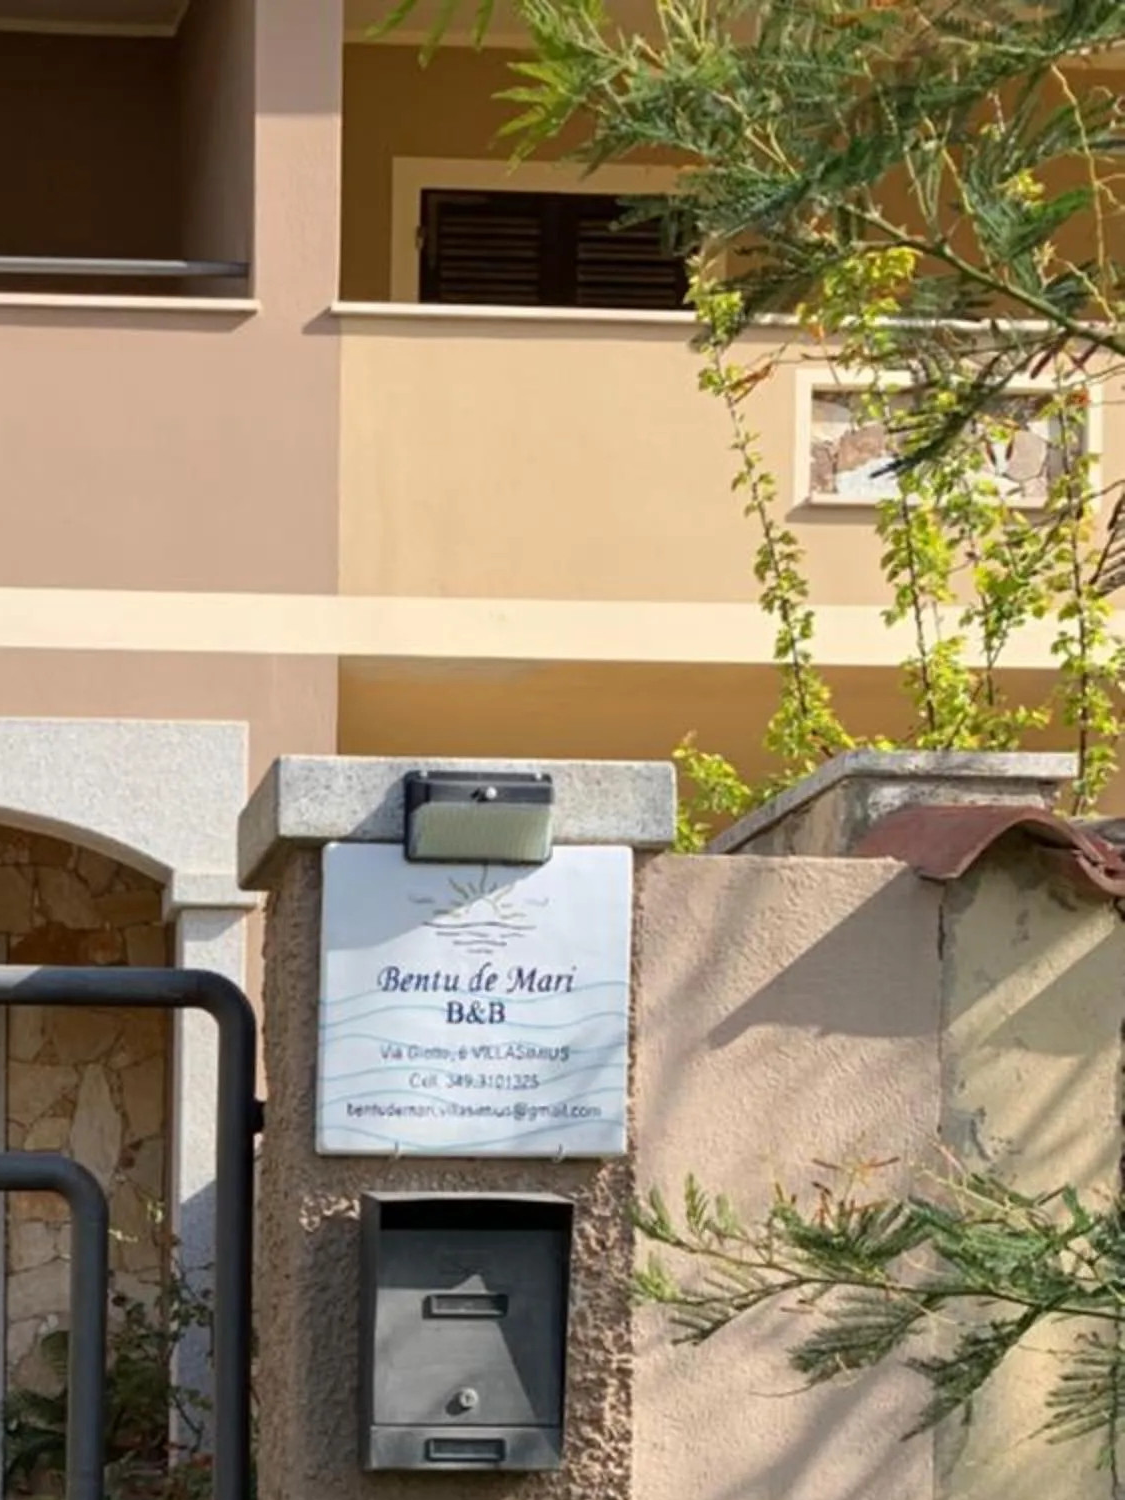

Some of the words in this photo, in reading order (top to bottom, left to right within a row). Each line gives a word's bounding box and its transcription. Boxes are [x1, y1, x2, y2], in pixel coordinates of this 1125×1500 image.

[377, 965, 460, 993] Bentu
[468, 961, 499, 993] de
[506, 965, 577, 993] Mari
[445, 1001, 506, 1025] B&B
